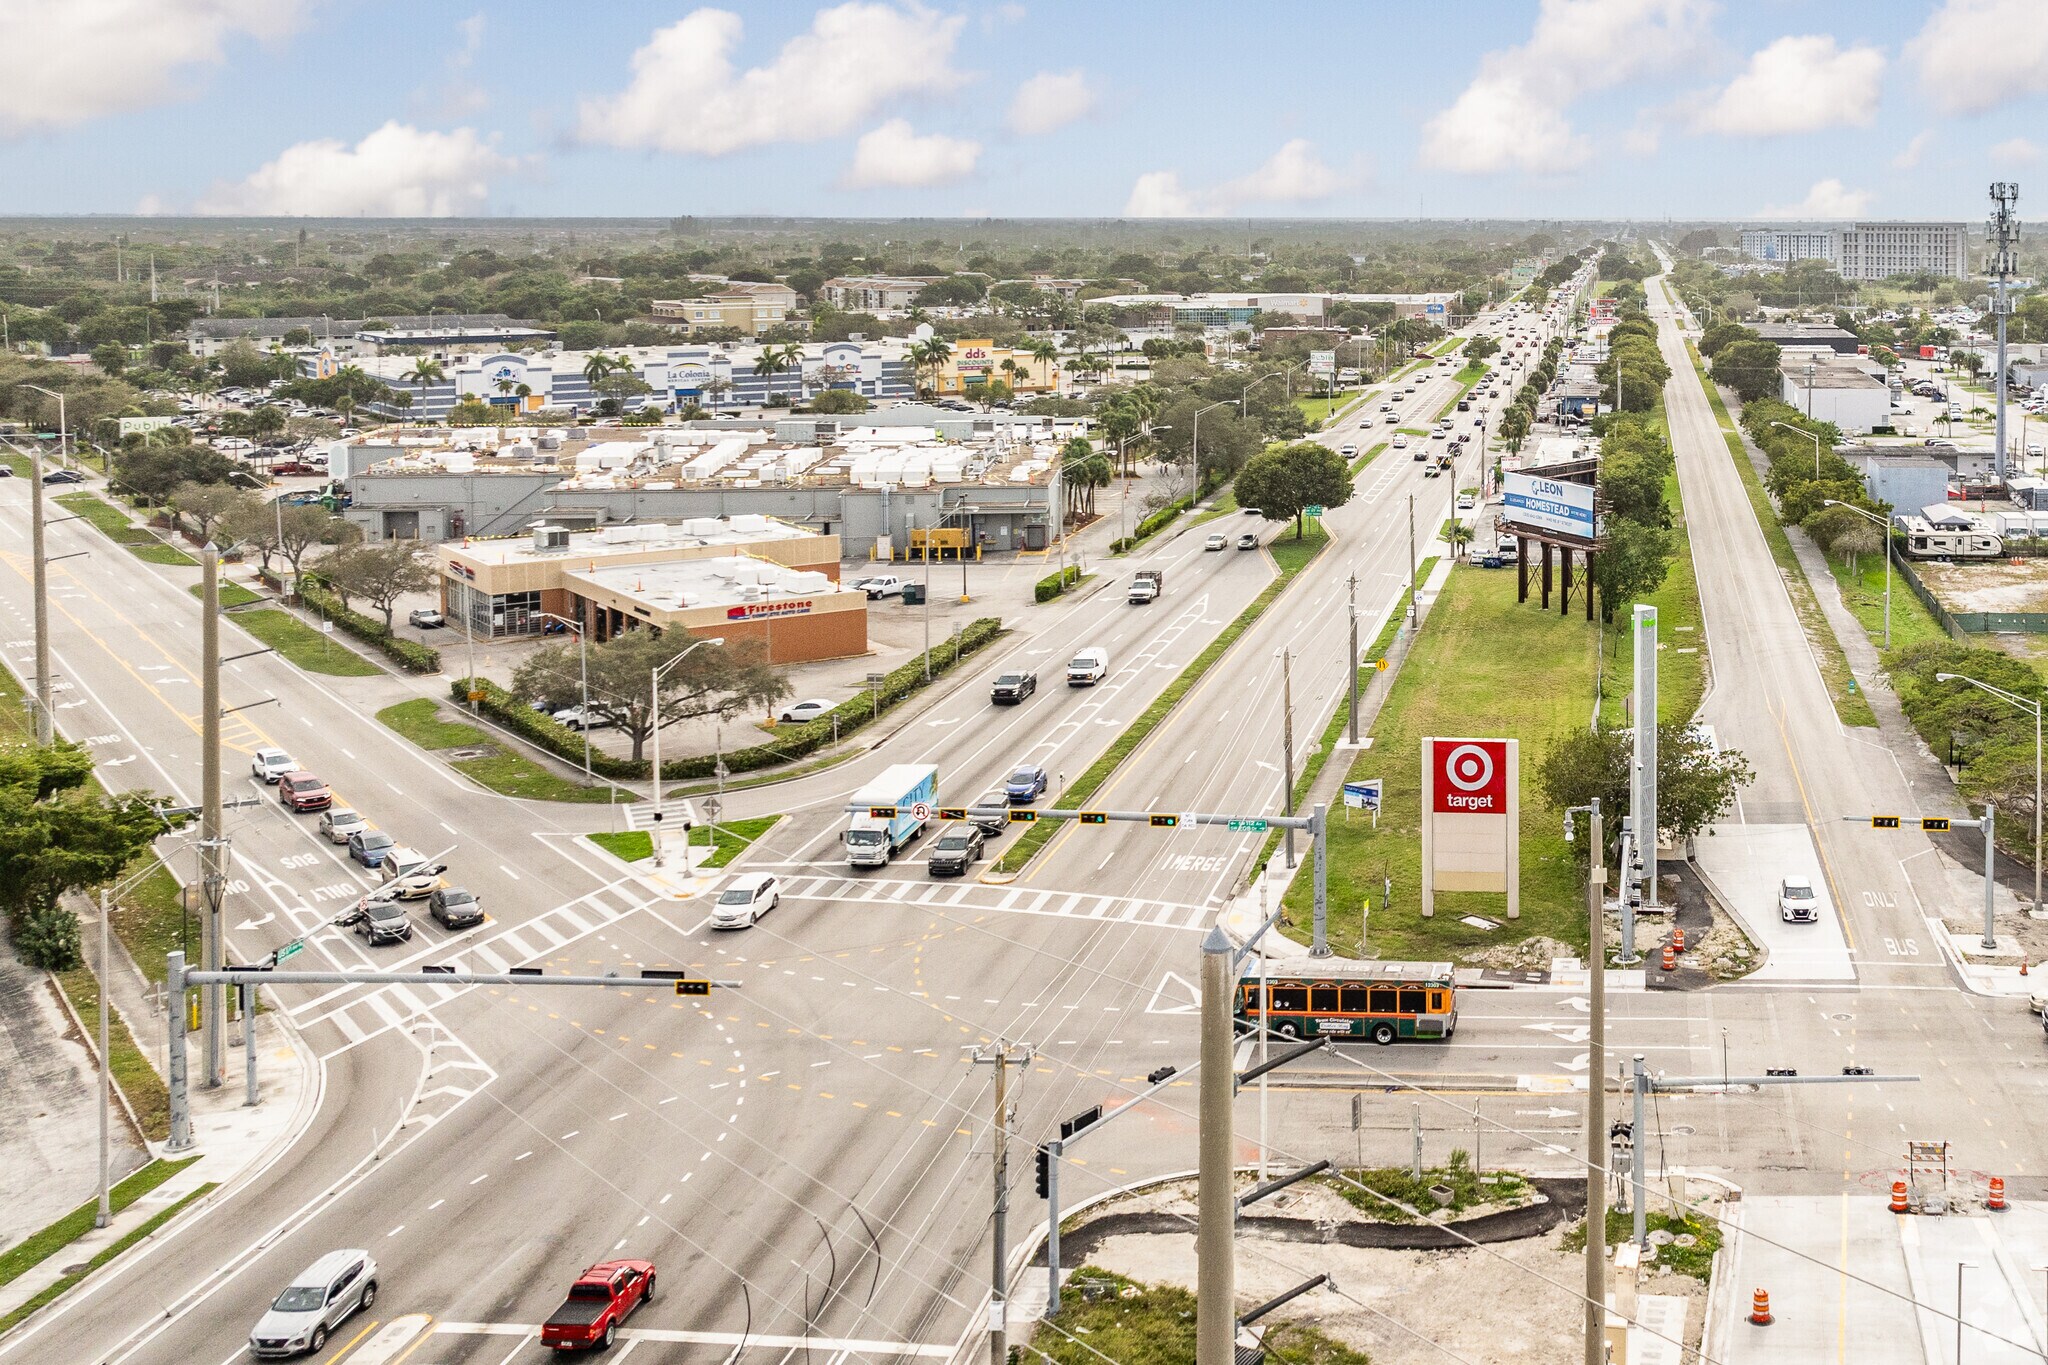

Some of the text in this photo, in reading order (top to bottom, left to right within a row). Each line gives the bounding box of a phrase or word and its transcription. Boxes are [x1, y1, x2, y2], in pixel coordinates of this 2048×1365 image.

[966, 348, 985, 358] dd's
[679, 370, 710, 378] Colonia
[846, 363, 859, 373] City
[1539, 481, 1564, 496] LEON
[1525, 497, 1570, 516] HOMESTEAD
[746, 600, 812, 614] Firestone
[1447, 793, 1493, 810] target
[280, 852, 320, 869] BUS
[1169, 854, 1228, 872] MERGE
[309, 882, 358, 902] ONLY
[1862, 891, 1898, 908] ONLY
[1883, 937, 1919, 956] BUS
